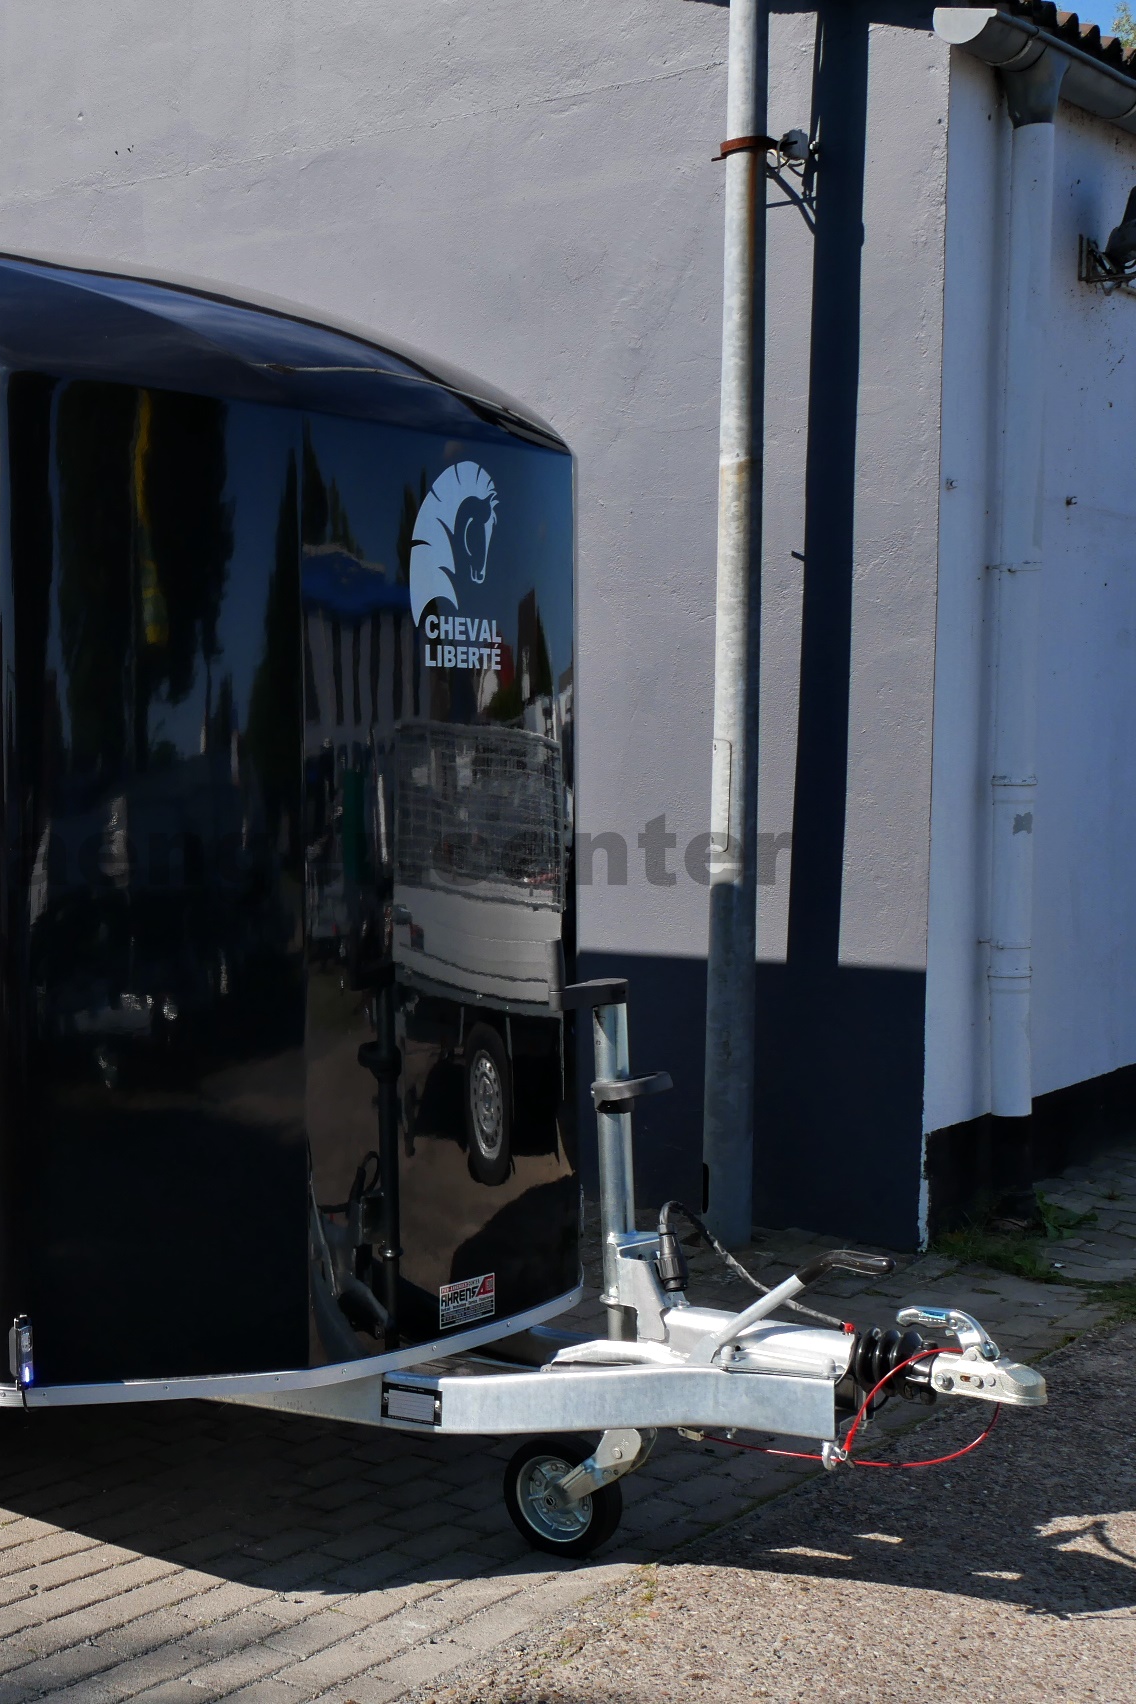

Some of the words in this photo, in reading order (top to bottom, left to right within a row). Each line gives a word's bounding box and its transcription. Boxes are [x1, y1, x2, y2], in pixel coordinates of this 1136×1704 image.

[425, 614, 502, 643] CHEVAL
[425, 643, 502, 671] LIBERTÉ
[441, 1285, 480, 1308] AHRENS
